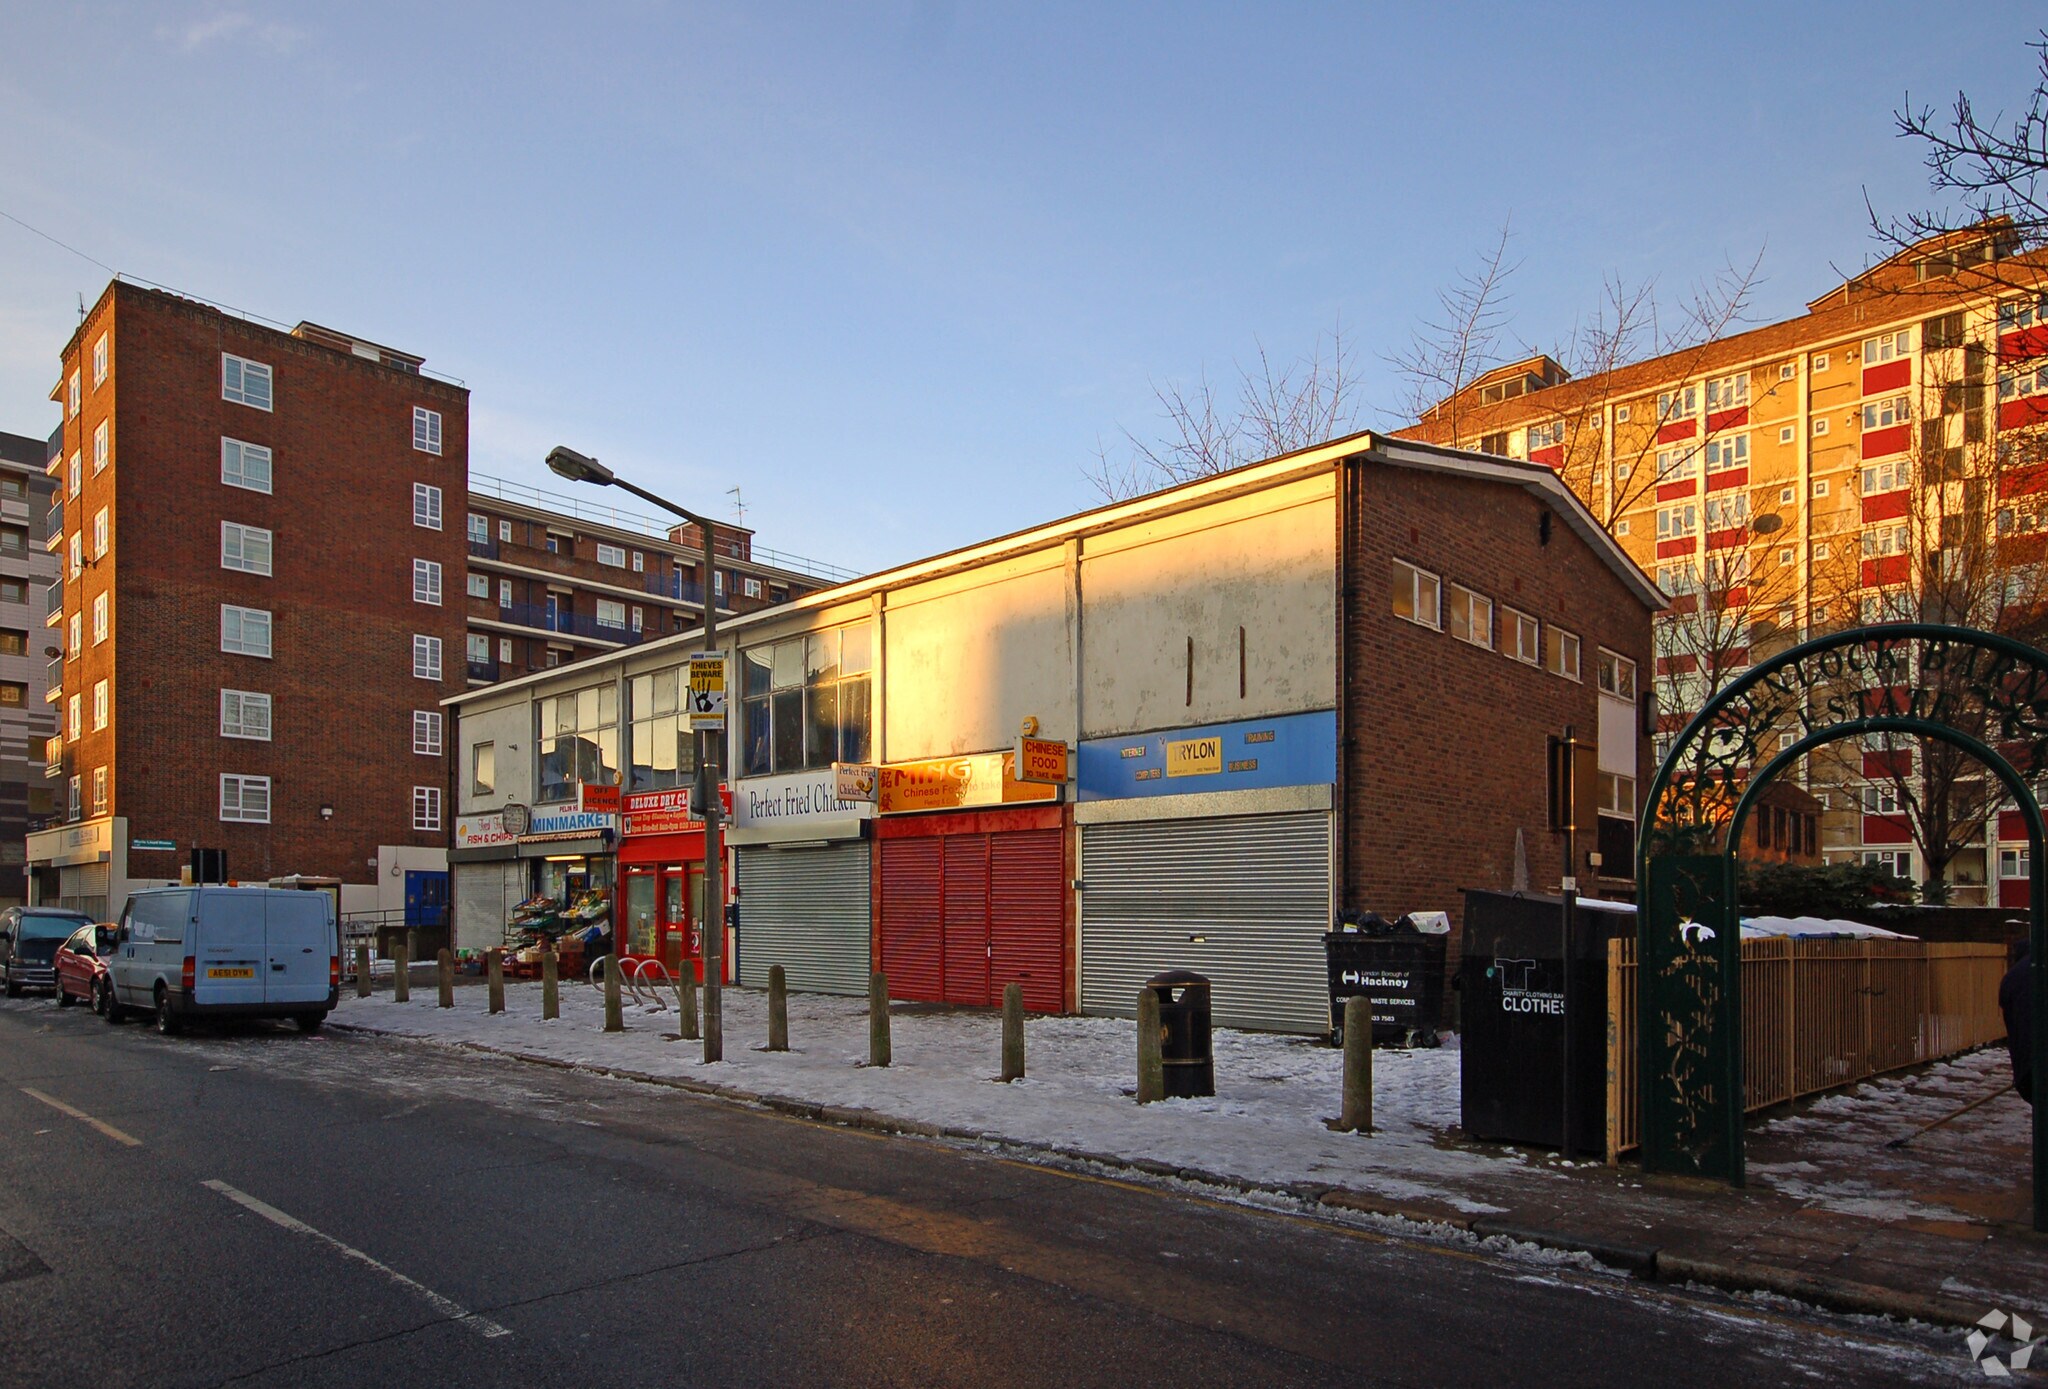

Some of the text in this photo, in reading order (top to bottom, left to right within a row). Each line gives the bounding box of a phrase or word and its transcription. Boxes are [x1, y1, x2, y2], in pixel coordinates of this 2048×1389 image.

[691, 661, 722, 670] THIEVES
[691, 670, 722, 678] BEWARE
[1797, 687, 1956, 732] ESTATE
[1245, 731, 1273, 743] RAINING
[1025, 741, 1064, 757] CHINESE
[1174, 741, 1216, 761] TRYLON
[1032, 756, 1058, 769] FOOD
[840, 766, 876, 778] Perfect Fried
[895, 760, 971, 787] MING
[1036, 771, 1050, 779] TAKE
[840, 783, 861, 796] Chicken
[903, 788, 940, 798] Chinese
[584, 797, 618, 805] LICENCE
[630, 795, 659, 809] DELUXE
[660, 793, 676, 807] DRY
[750, 789, 782, 819] Perfect
[785, 784, 811, 816] Fried
[533, 814, 610, 833] MINIMARKET
[467, 832, 513, 844] FISH & CHIPS
[1361, 977, 1409, 989] Hackney
